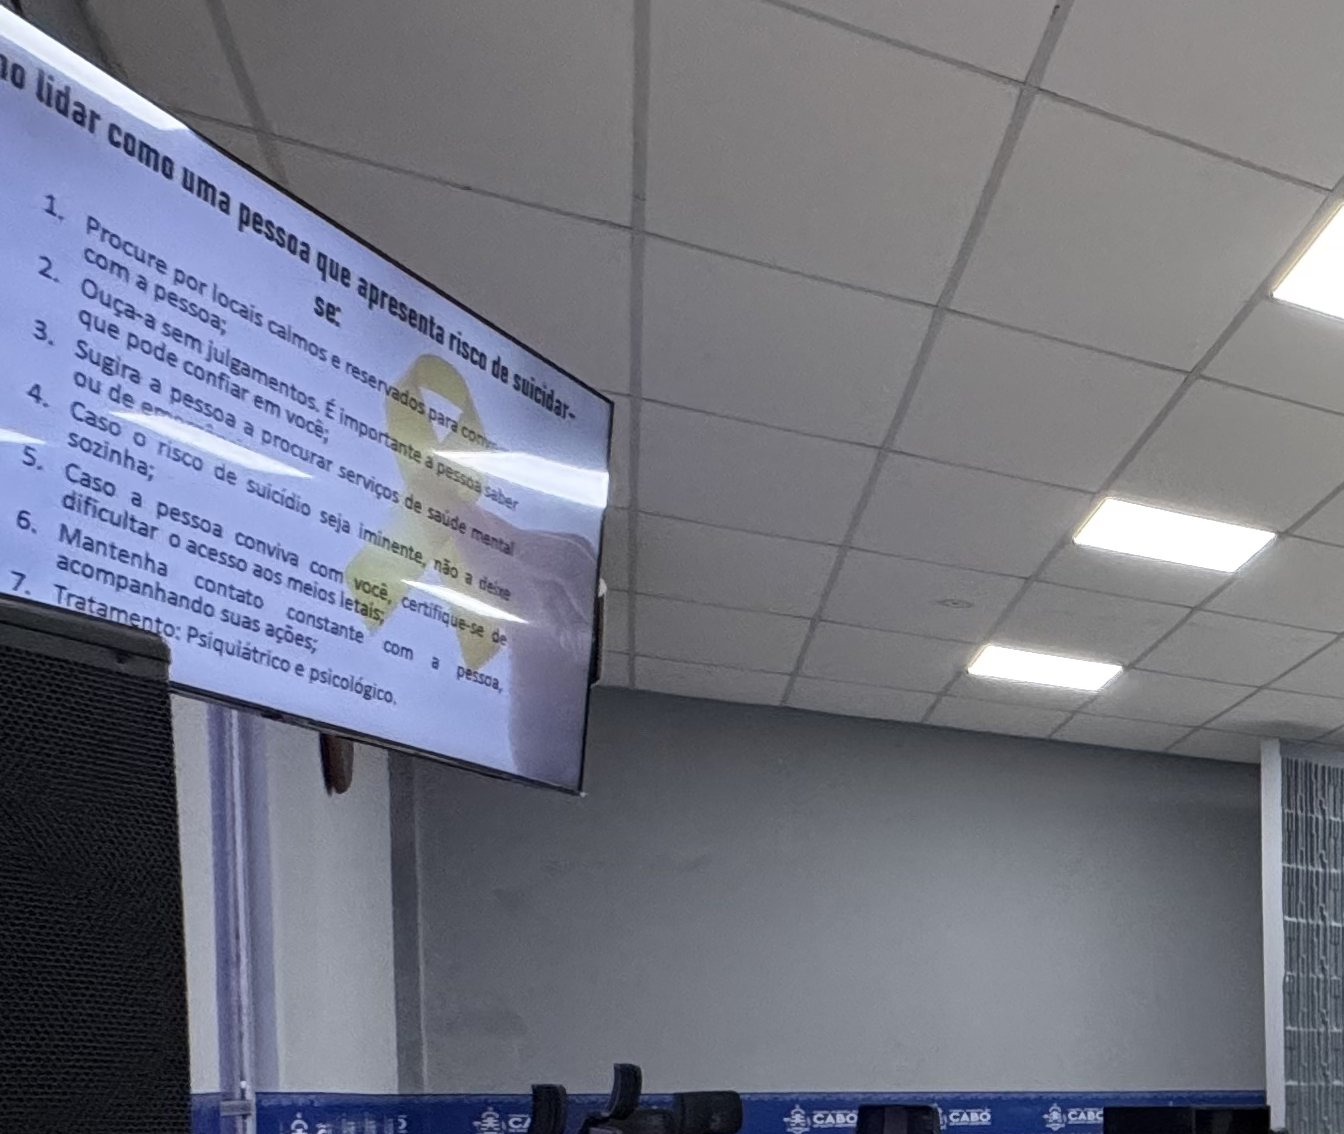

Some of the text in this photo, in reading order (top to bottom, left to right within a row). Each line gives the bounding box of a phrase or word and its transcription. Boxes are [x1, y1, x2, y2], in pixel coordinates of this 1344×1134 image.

[36, 68, 102, 134] lidar
[107, 122, 174, 181] como
[181, 166, 231, 216] uma
[237, 202, 311, 264] pessoa
[317, 250, 351, 288] que
[357, 276, 446, 346] apresenta
[448, 331, 488, 371] risco
[491, 356, 509, 384] de
[512, 371, 576, 421] suicidar-
[84, 247, 227, 336] com a pessoa;
[313, 295, 341, 328] se:
[43, 193, 458, 434] 1. Procure por locais calmos e reservados para
[78, 308, 120, 340] que
[127, 331, 178, 368] pode
[183, 359, 249, 401] confiar
[253, 394, 281, 418] em
[285, 409, 330, 444] você;
[33, 319, 54, 345] 3.
[75, 339, 141, 385] Sugira
[149, 377, 161, 394] a
[170, 385, 236, 428] pessoa
[243, 421, 254, 437] a
[261, 429, 333, 471] procurar
[338, 465, 400, 504] serviços
[404, 493, 422, 514] de
[427, 506, 467, 535] saúde
[470, 526, 515, 556] mental
[38, 255, 60, 283] 2.
[81, 278, 156, 330] Ouça-a
[161, 321, 202, 354] sem
[206, 339, 320, 412] julgamentos.
[325, 397, 337, 419] É
[339, 406, 422, 464] importante
[424, 455, 434, 469] a
[436, 462, 482, 496] pessoa
[485, 483, 519, 511] saber
[73, 371, 135, 409] ou de
[26, 383, 50, 407] 4.
[70, 401, 122, 437] Caso
[133, 431, 146, 448] o
[158, 439, 204, 472] risco
[214, 463, 237, 486] de
[246, 475, 312, 517] suicídio
[320, 509, 350, 535] seja
[358, 522, 427, 565] iminente,
[434, 554, 459, 579] não
[465, 571, 473, 586] a
[478, 575, 512, 601] deixe
[68, 431, 155, 482] sozinha;
[16, 509, 503, 694] 6. Mantenha contato constante com a pessoa,
[22, 445, 508, 647] 5. Caso a pessoa conviva com você, certifique-se de
[56, 552, 318, 654] acompanhando suas ações;
[61, 490, 385, 625] dificultar o acesso aos meios letais;
[9, 571, 397, 705] 7. Tratamento: Psiquiátrico e psicológico.
[812, 1113, 858, 1124] CABO
[949, 1112, 991, 1123] CABO
